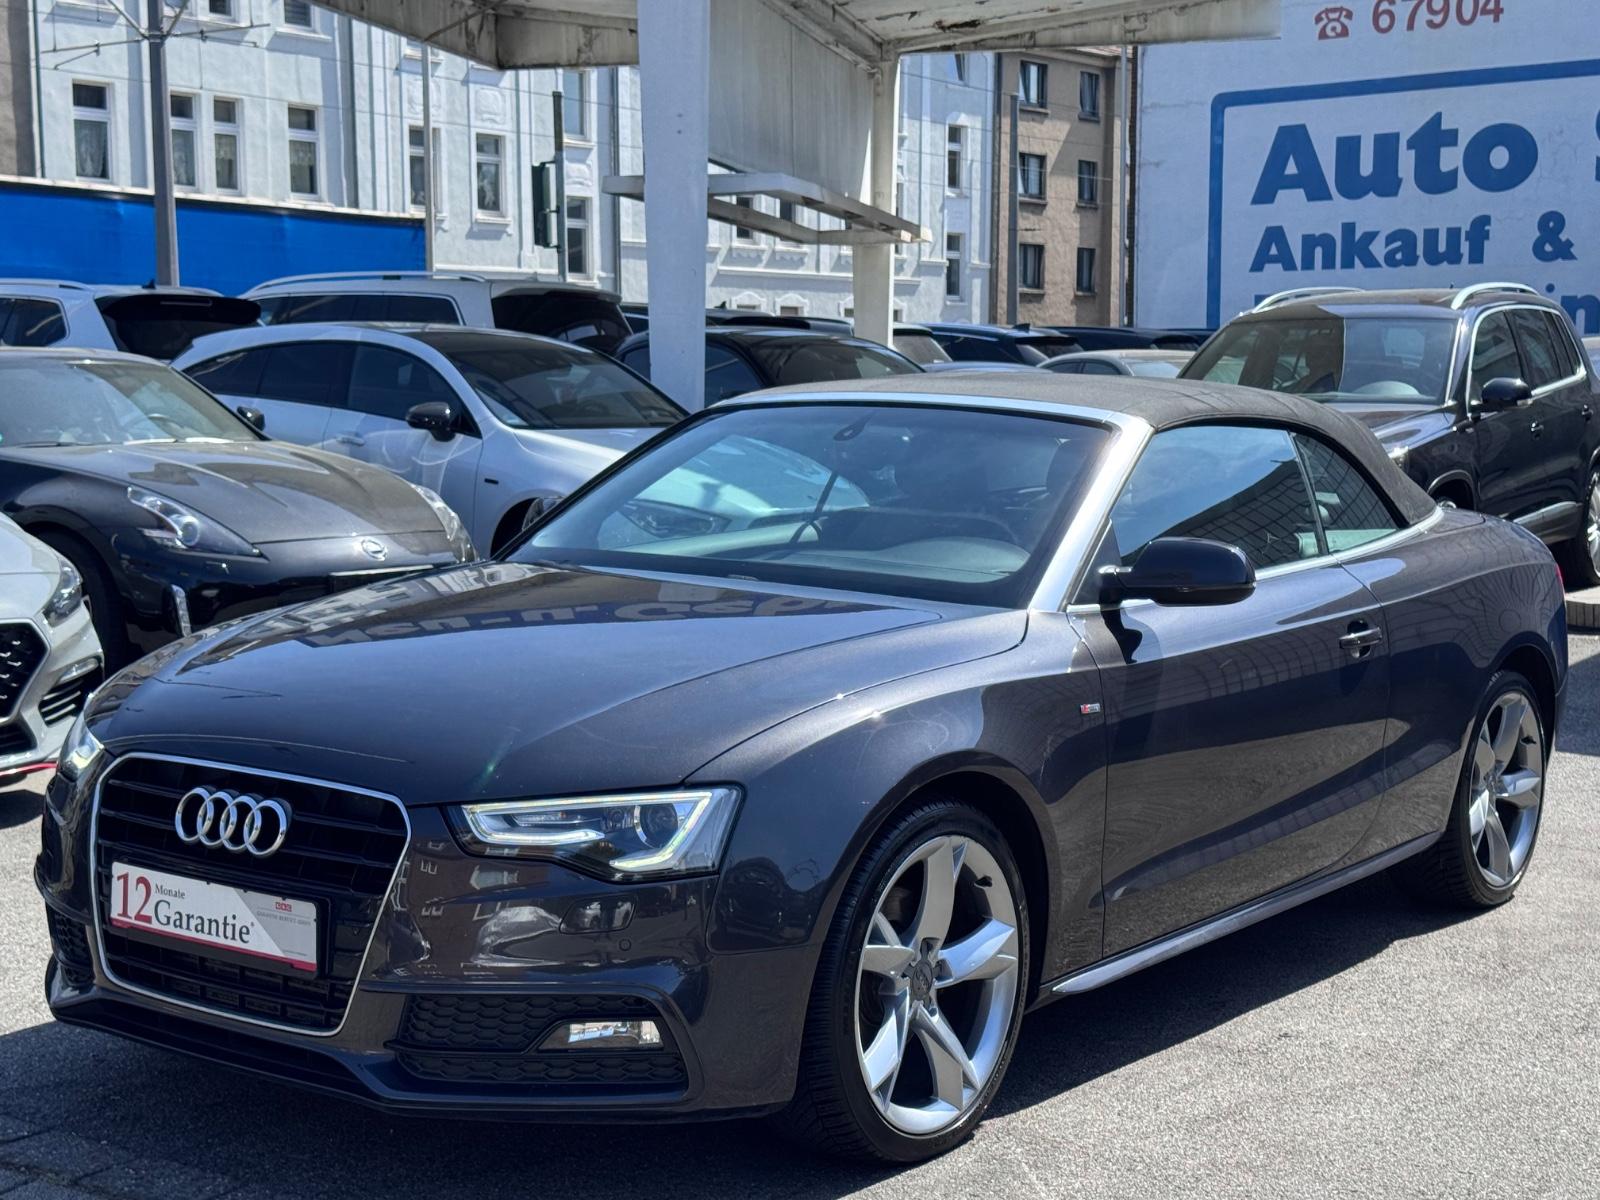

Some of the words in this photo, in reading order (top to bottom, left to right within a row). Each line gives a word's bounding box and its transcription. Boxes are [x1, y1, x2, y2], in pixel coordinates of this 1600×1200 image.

[1250, 111, 1539, 205] Auto
[1249, 214, 1492, 273] Ankauf
[1532, 210, 1578, 263] &
[116, 871, 153, 925] 12
[154, 883, 186, 900] Monate
[154, 899, 251, 944] Garantie
